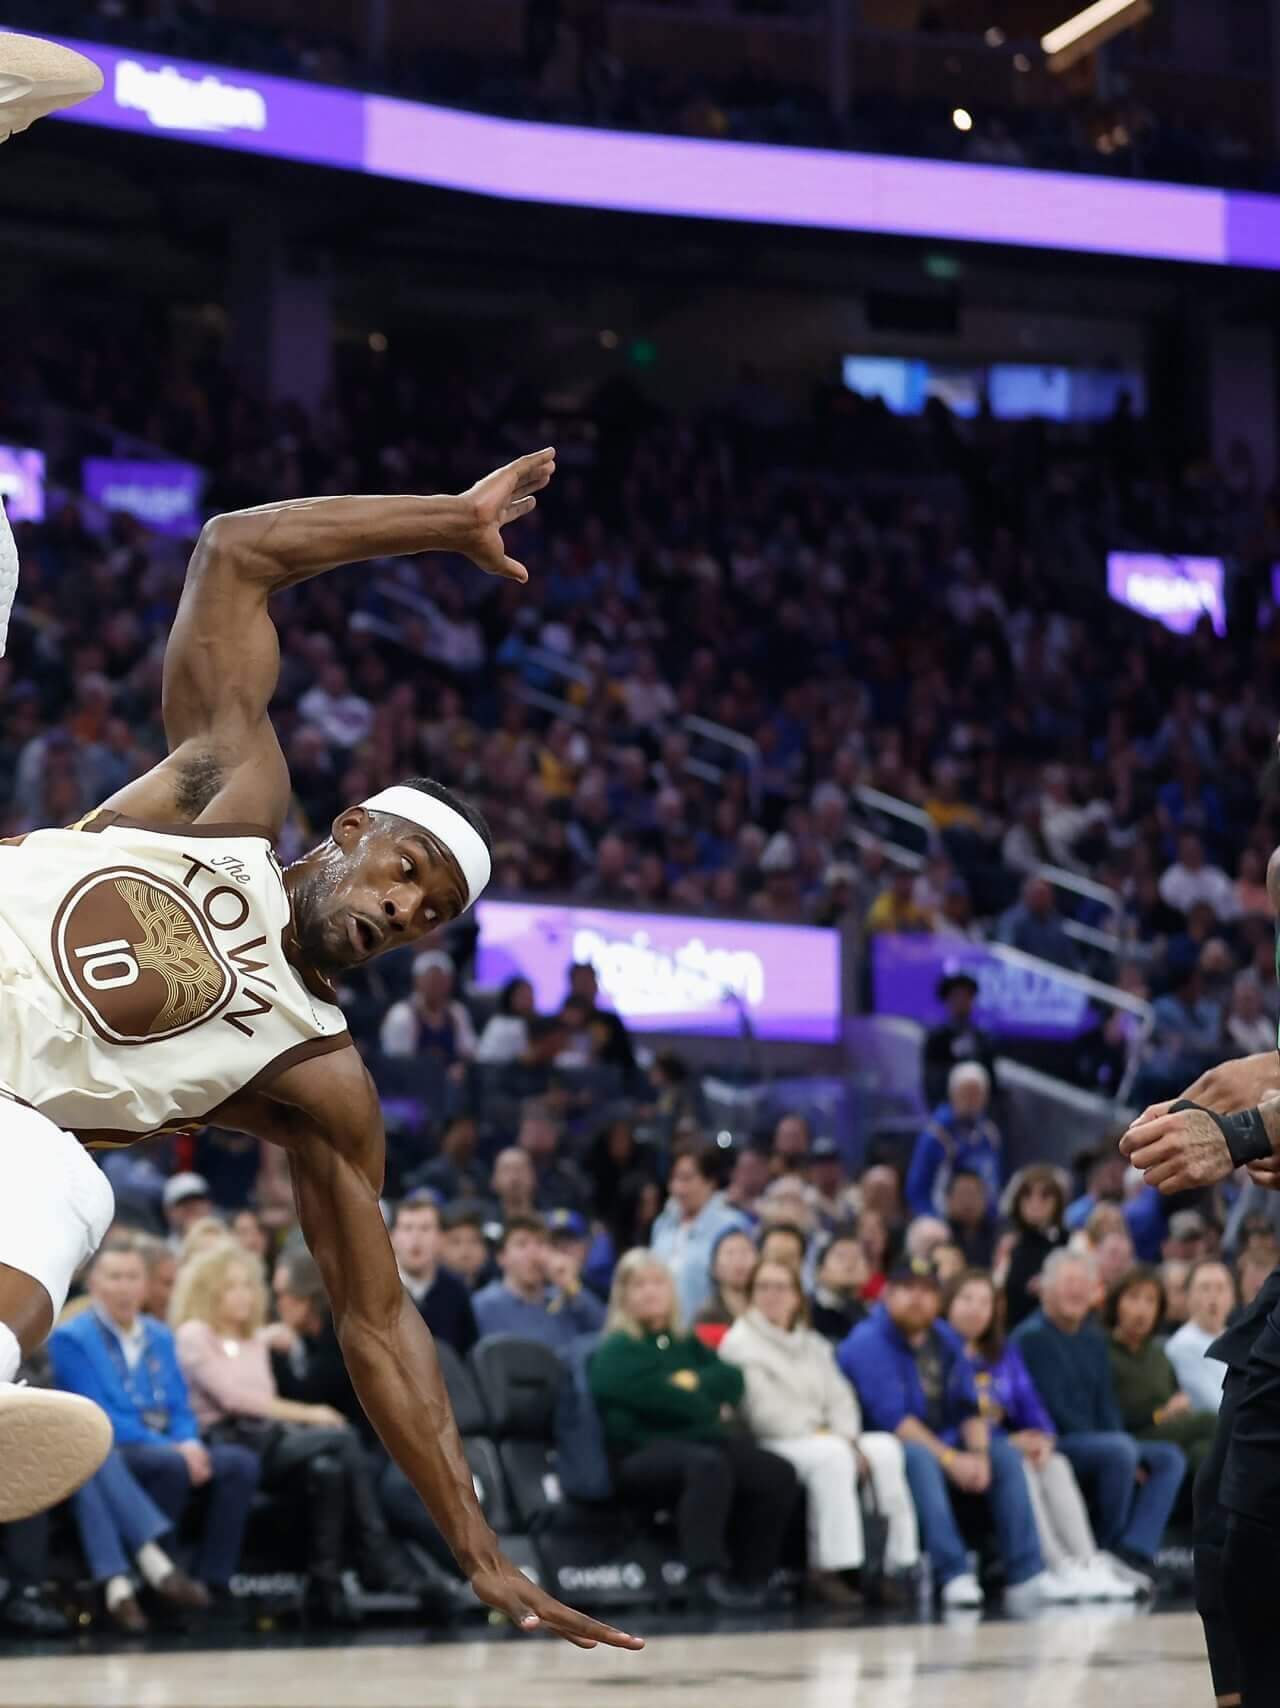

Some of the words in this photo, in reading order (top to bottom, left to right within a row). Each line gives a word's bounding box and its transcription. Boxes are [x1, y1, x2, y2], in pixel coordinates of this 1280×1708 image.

[210, 855, 252, 885] The
[74, 939, 140, 990] 10
[182, 853, 278, 1038] TOWN
